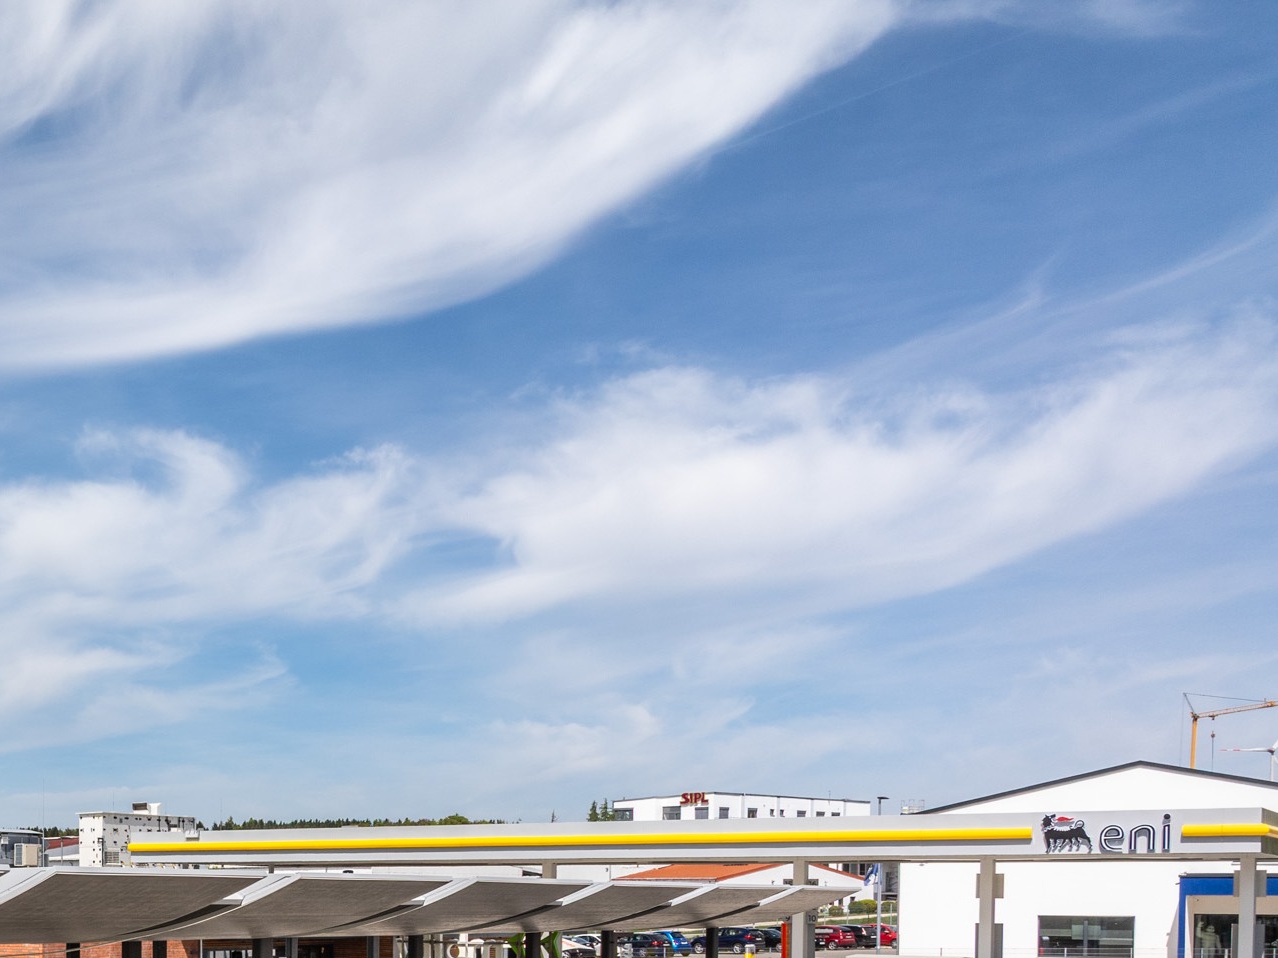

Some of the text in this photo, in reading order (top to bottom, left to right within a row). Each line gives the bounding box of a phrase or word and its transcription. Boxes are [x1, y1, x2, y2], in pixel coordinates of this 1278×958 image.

[680, 792, 709, 805] SIPL
[1099, 813, 1171, 852] eni
[808, 914, 817, 922] 10
